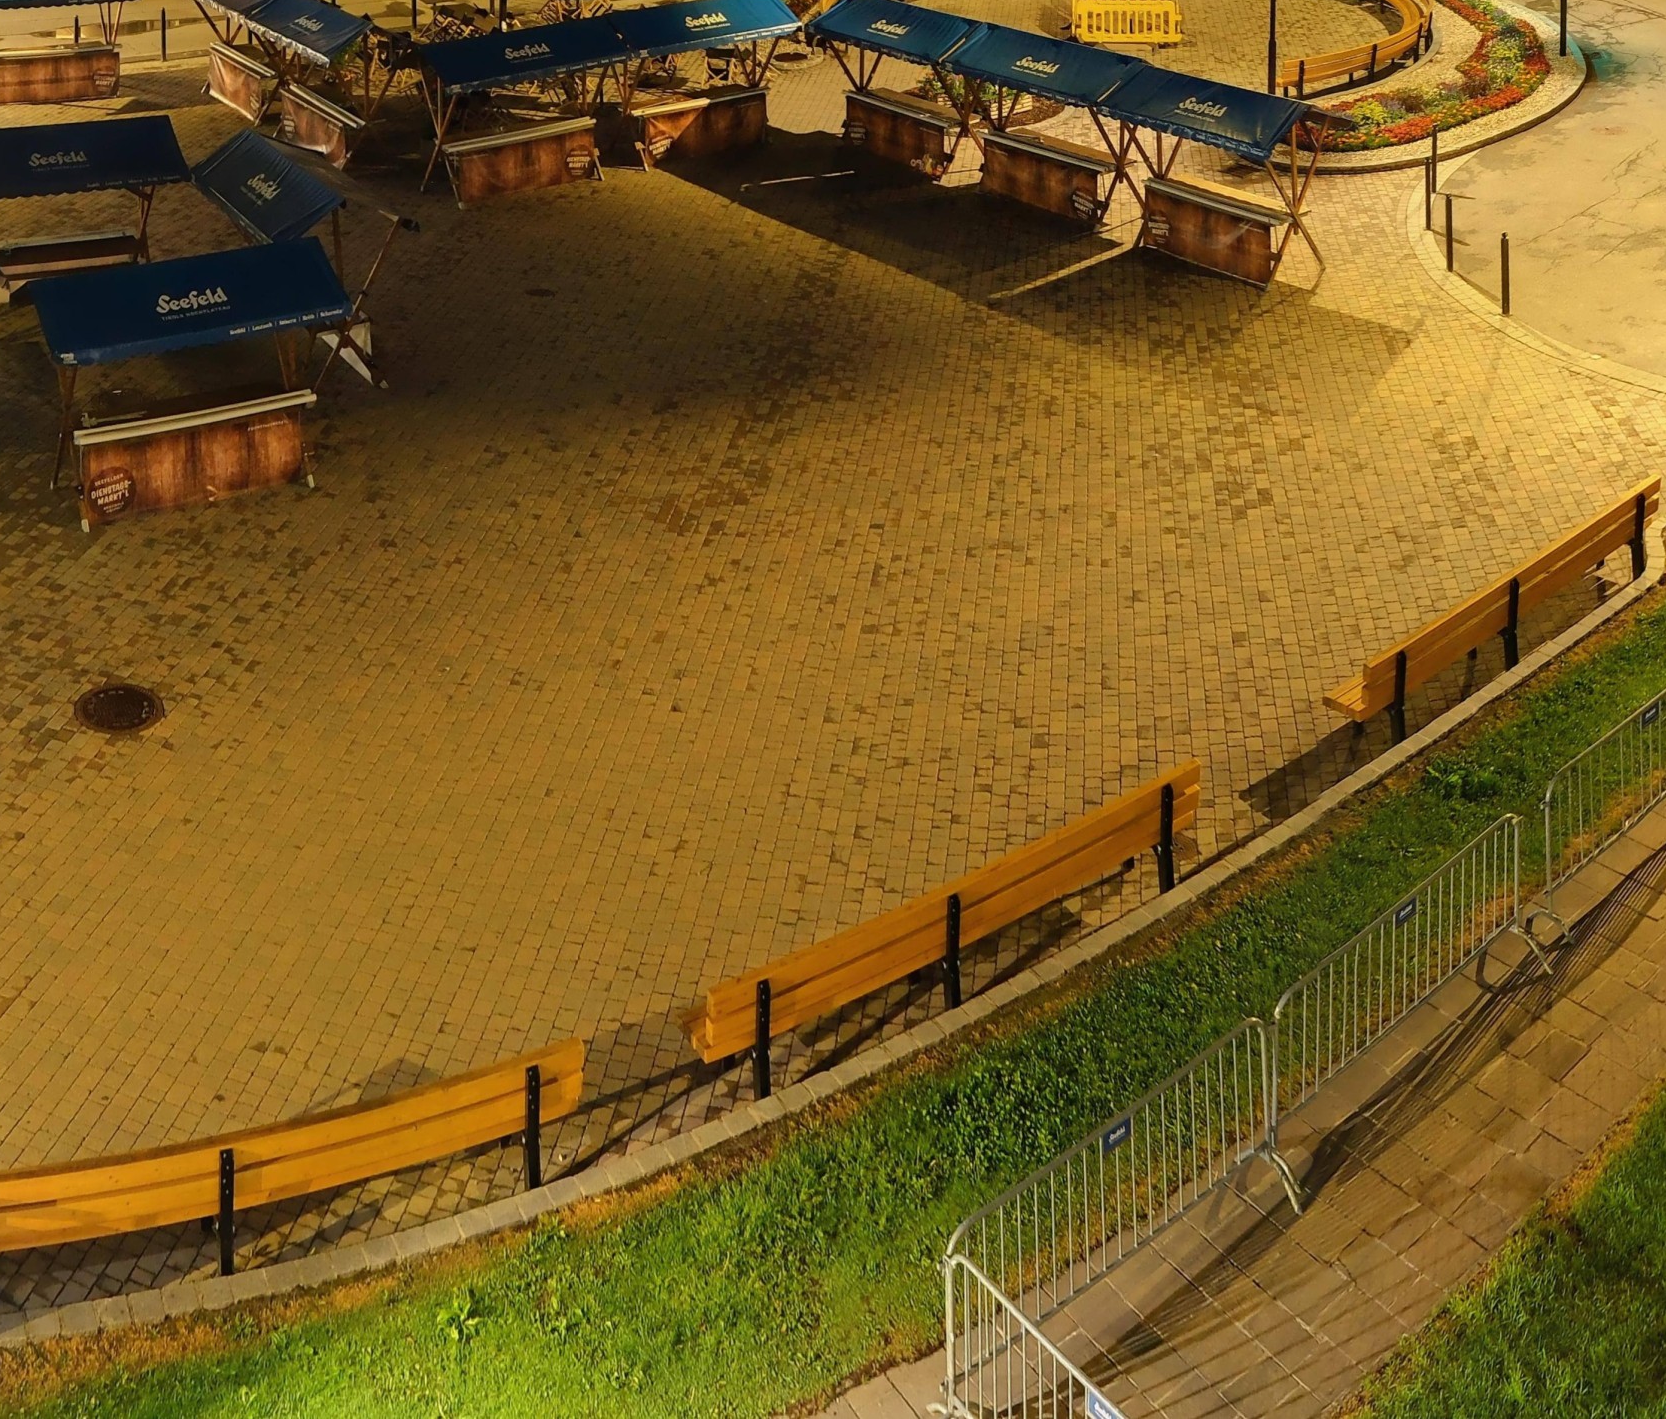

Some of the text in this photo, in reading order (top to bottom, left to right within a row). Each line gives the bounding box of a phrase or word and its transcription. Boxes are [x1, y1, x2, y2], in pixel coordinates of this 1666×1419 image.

[685, 13, 728, 28] Seefeld
[504, 43, 551, 60] Seefeld
[1015, 55, 1061, 74] Seefeld
[1178, 96, 1229, 118] Seefeld
[28, 150, 88, 168] Seefeld
[156, 286, 229, 315] Seefeld
